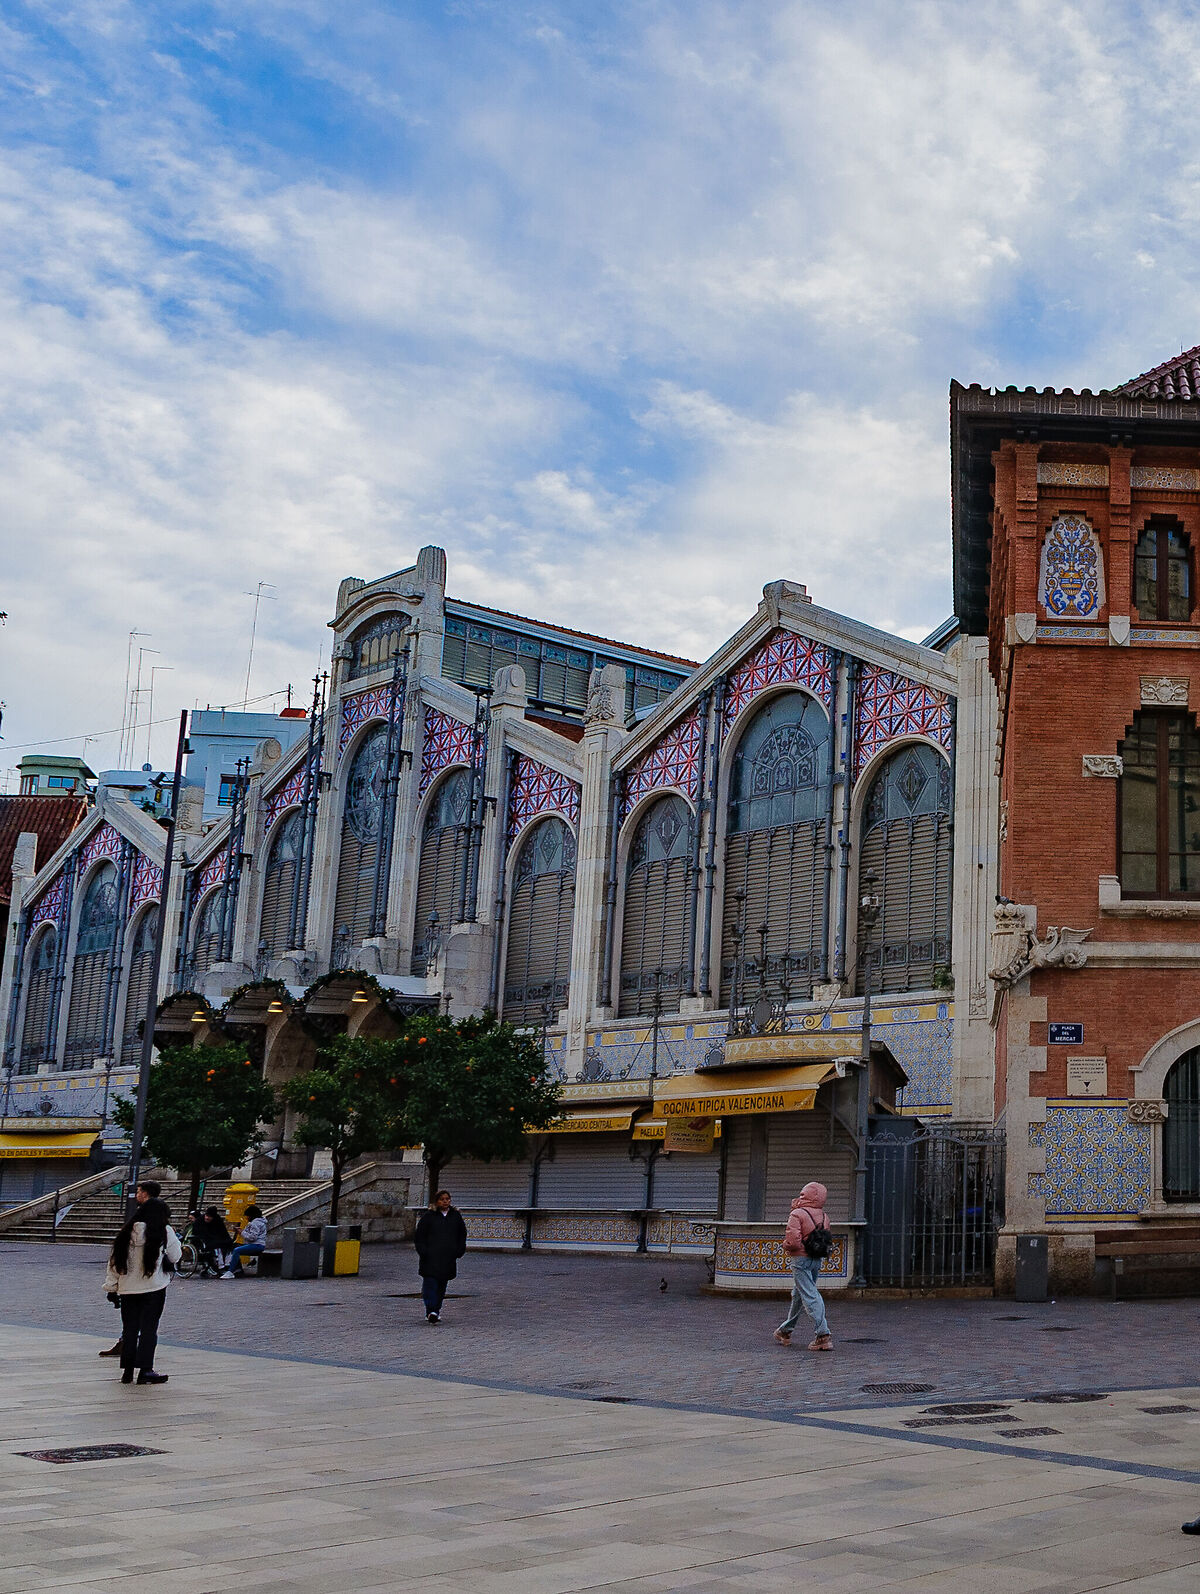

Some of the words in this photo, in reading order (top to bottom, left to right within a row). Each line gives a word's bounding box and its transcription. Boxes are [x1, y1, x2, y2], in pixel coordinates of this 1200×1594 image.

[663, 1101, 696, 1115] COCINA
[697, 1099, 725, 1113] TIPICA
[728, 1095, 785, 1110] VALENCIANA
[590, 1119, 613, 1129] CENTRAL
[640, 1128, 664, 1137] PAELLAS
